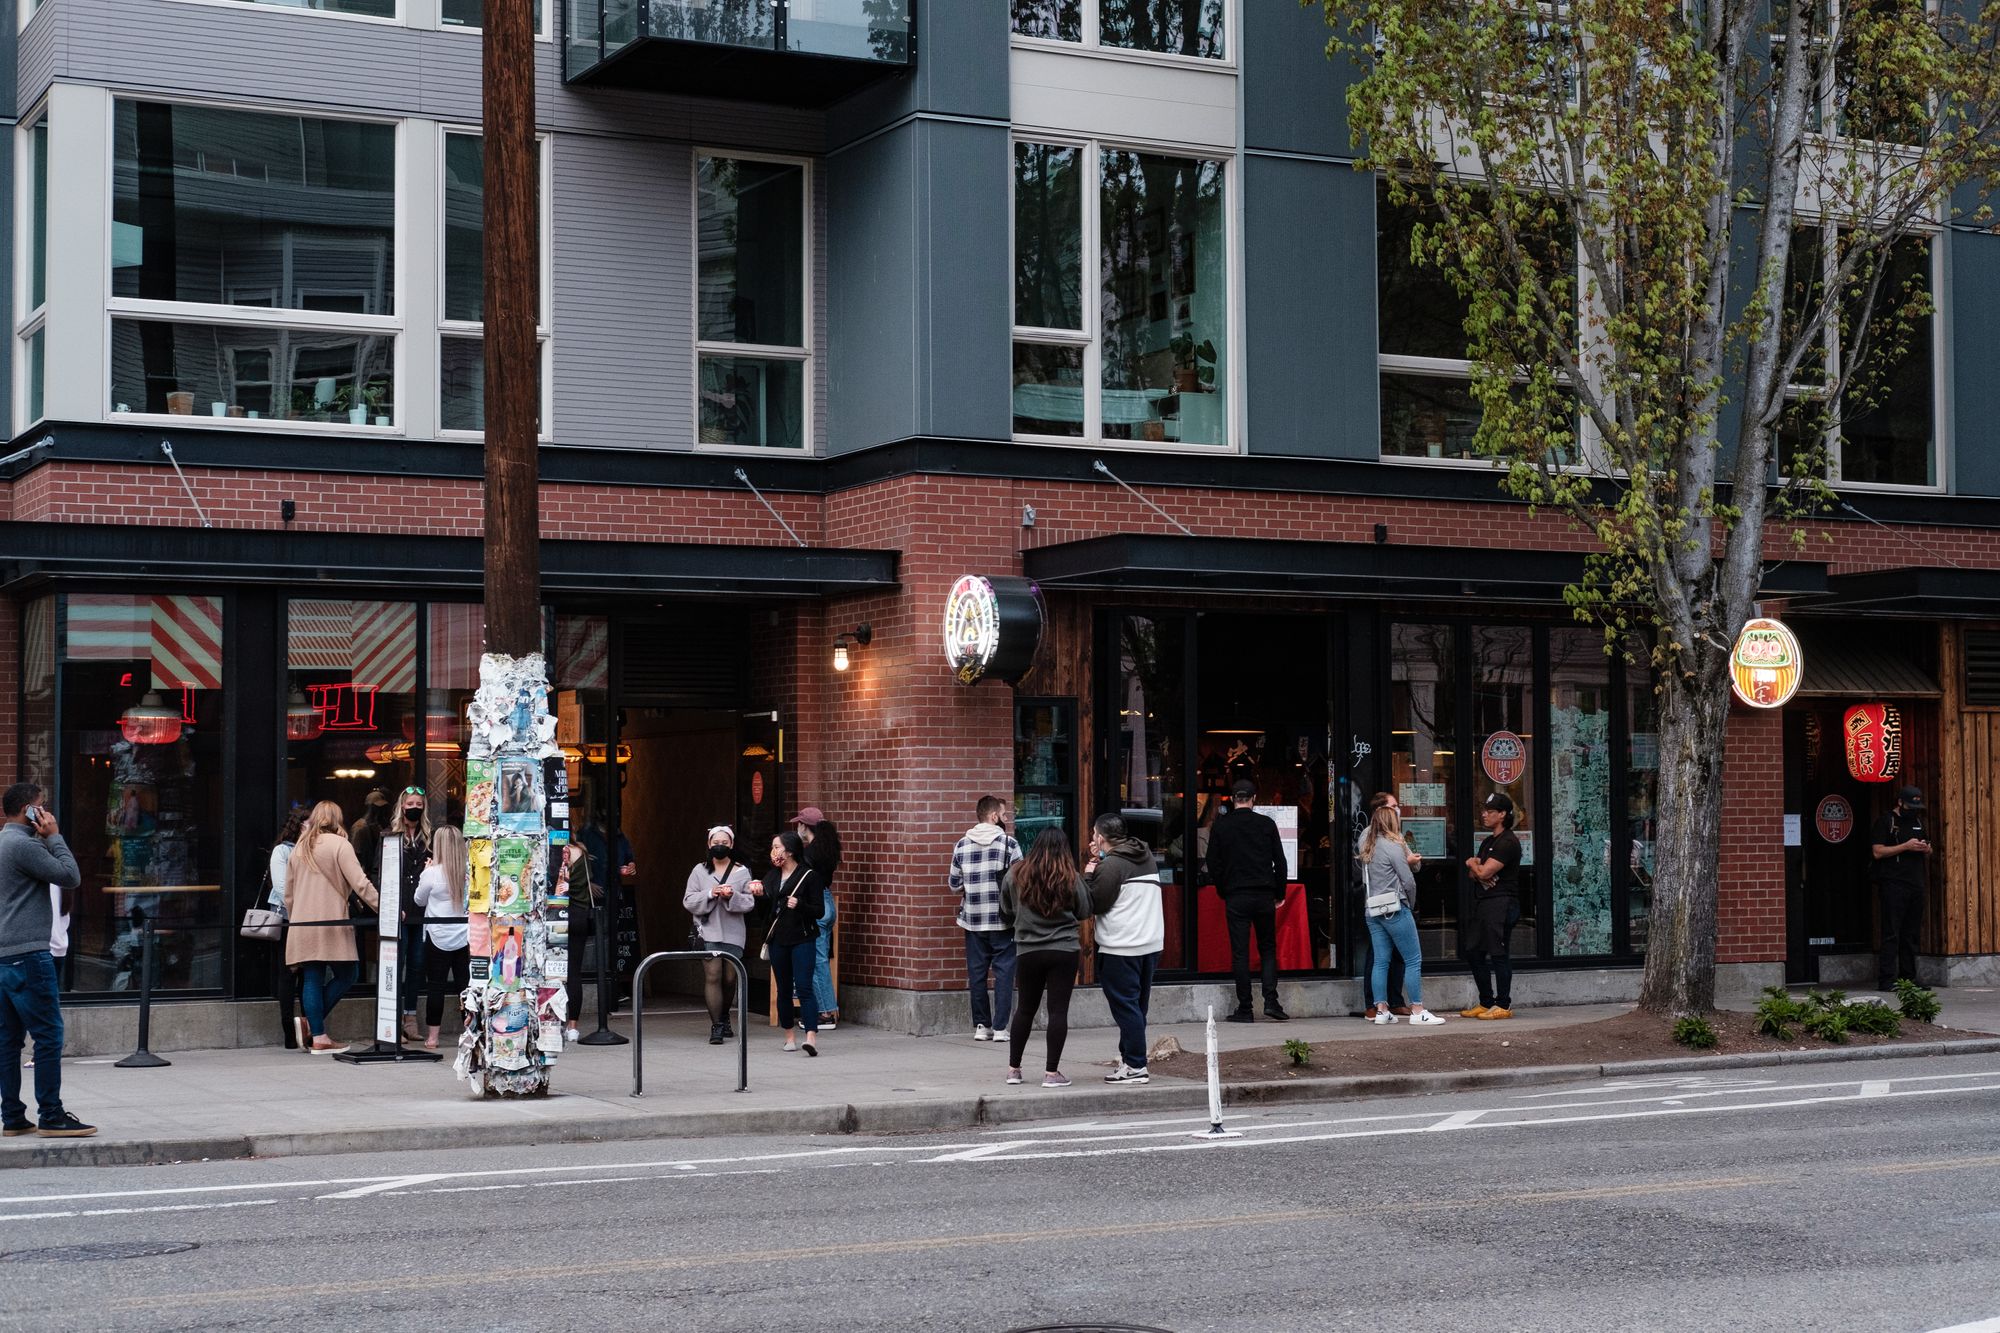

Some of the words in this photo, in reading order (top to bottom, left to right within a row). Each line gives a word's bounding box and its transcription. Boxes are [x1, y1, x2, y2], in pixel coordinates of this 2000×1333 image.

[1879, 704, 1902, 778] 居酒屋
[1498, 761, 1510, 769] TAKU
[1412, 807, 1434, 816] MENU
